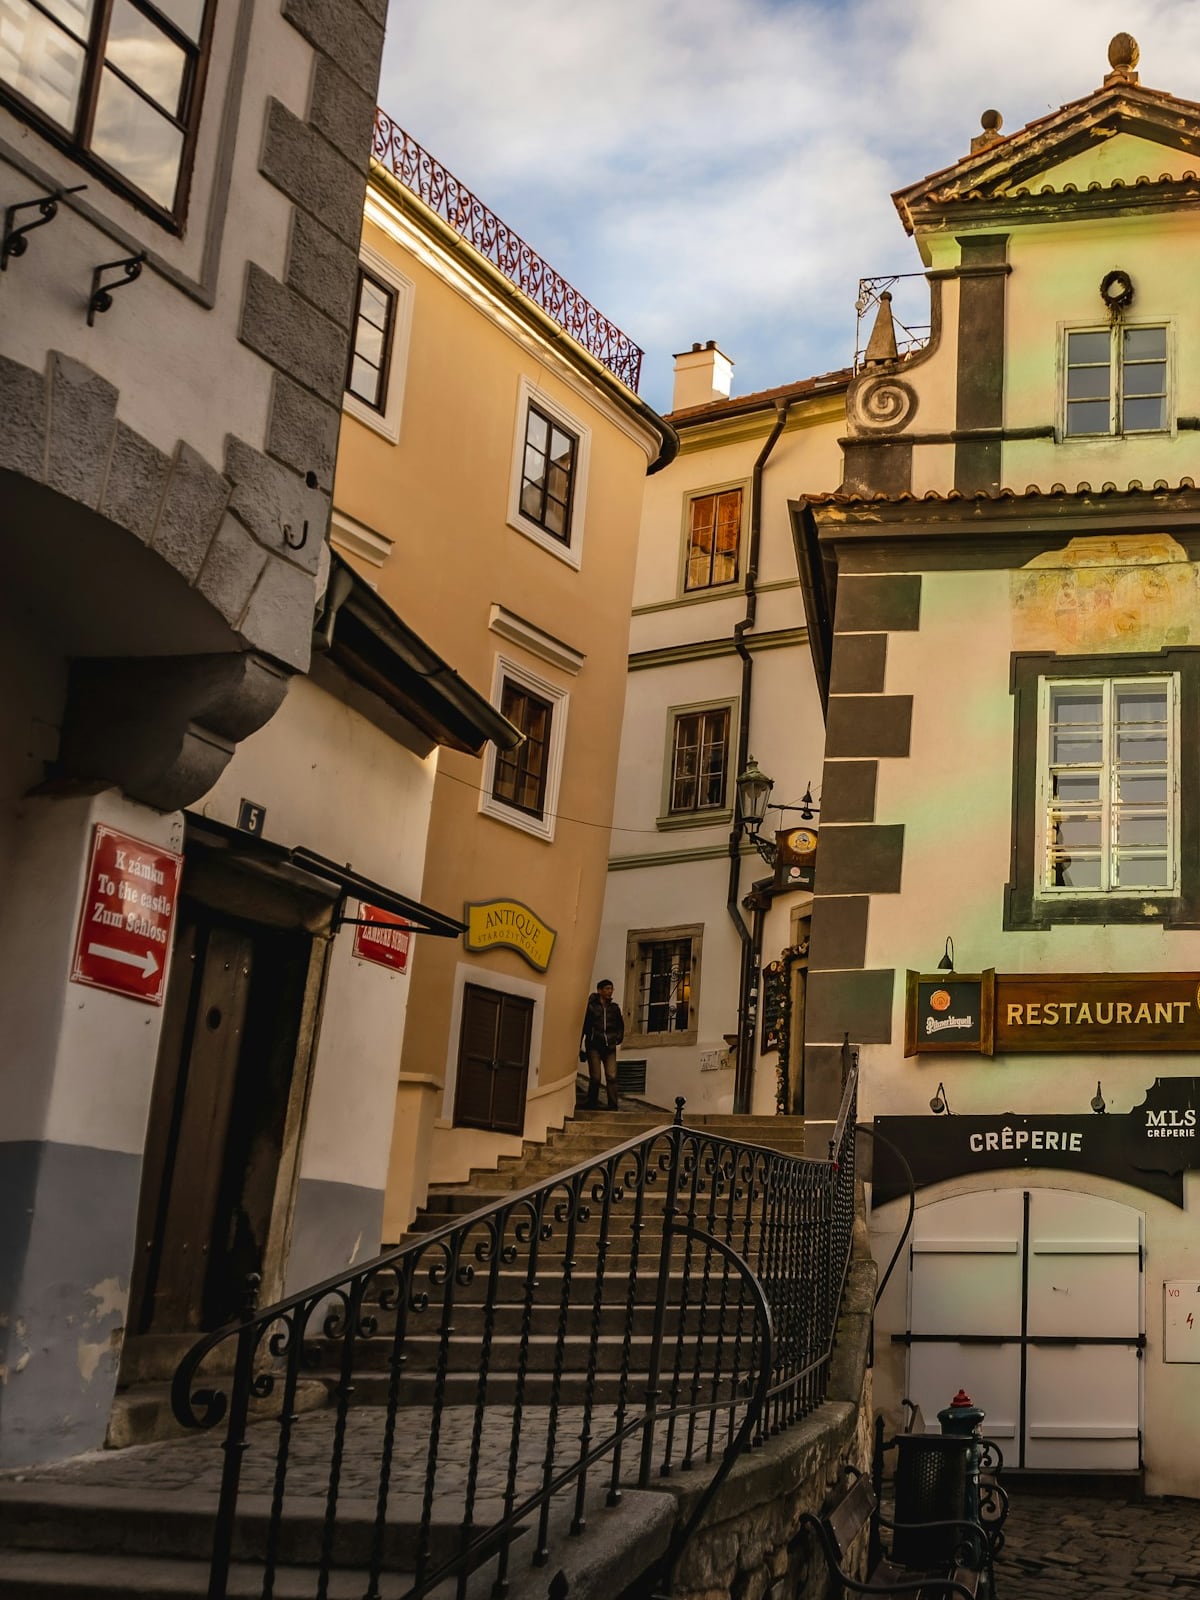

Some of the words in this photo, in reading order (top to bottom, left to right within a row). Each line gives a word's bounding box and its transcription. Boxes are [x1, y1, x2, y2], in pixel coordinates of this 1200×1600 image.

[248, 809, 259, 831] 5
[114, 849, 126, 869] K
[128, 856, 165, 886] zámku
[98, 873, 116, 897] To
[118, 880, 139, 904] the
[140, 892, 171, 917] castle
[92, 902, 123, 929] Zum
[125, 911, 167, 945] Schloss
[485, 909, 541, 945] ANTIQUE
[1006, 1001, 1191, 1026] RESTAURANT
[1145, 1109, 1197, 1127] MLS
[969, 1126, 1083, 1152] CRÊPERIE
[1147, 1127, 1195, 1138] CRÊPERIE
